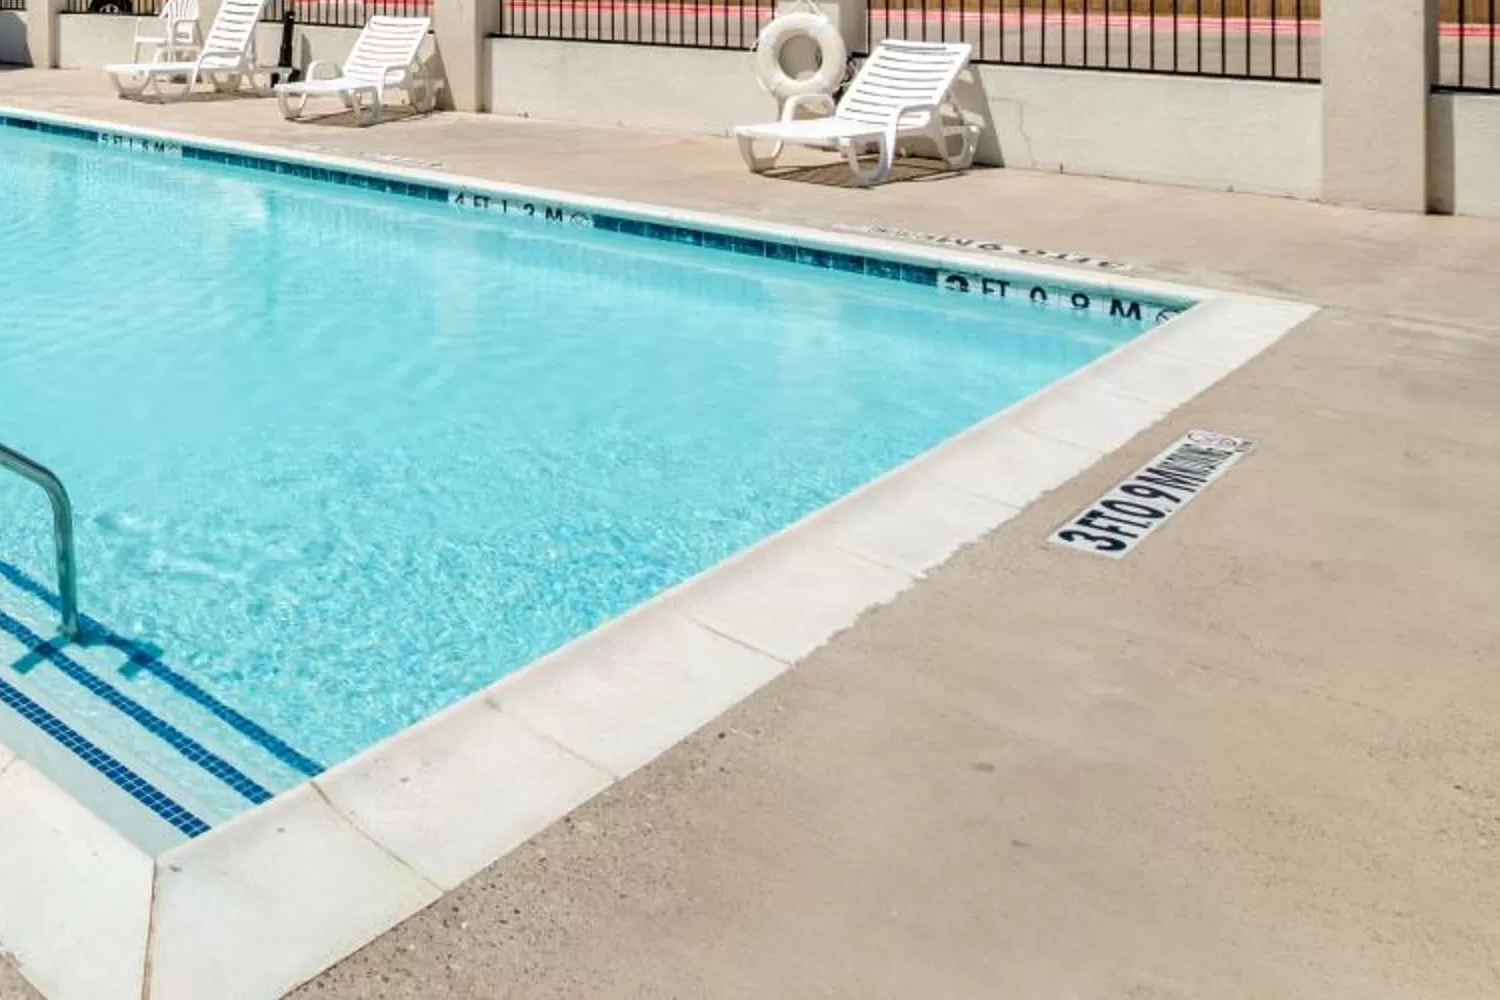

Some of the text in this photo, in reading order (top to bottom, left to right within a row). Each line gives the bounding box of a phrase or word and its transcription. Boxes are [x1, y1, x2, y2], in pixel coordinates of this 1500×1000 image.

[981, 278, 1010, 298] FT
[1110, 299, 1141, 320] M
[1058, 529, 1127, 552] 3
[1135, 467, 1208, 493] M
